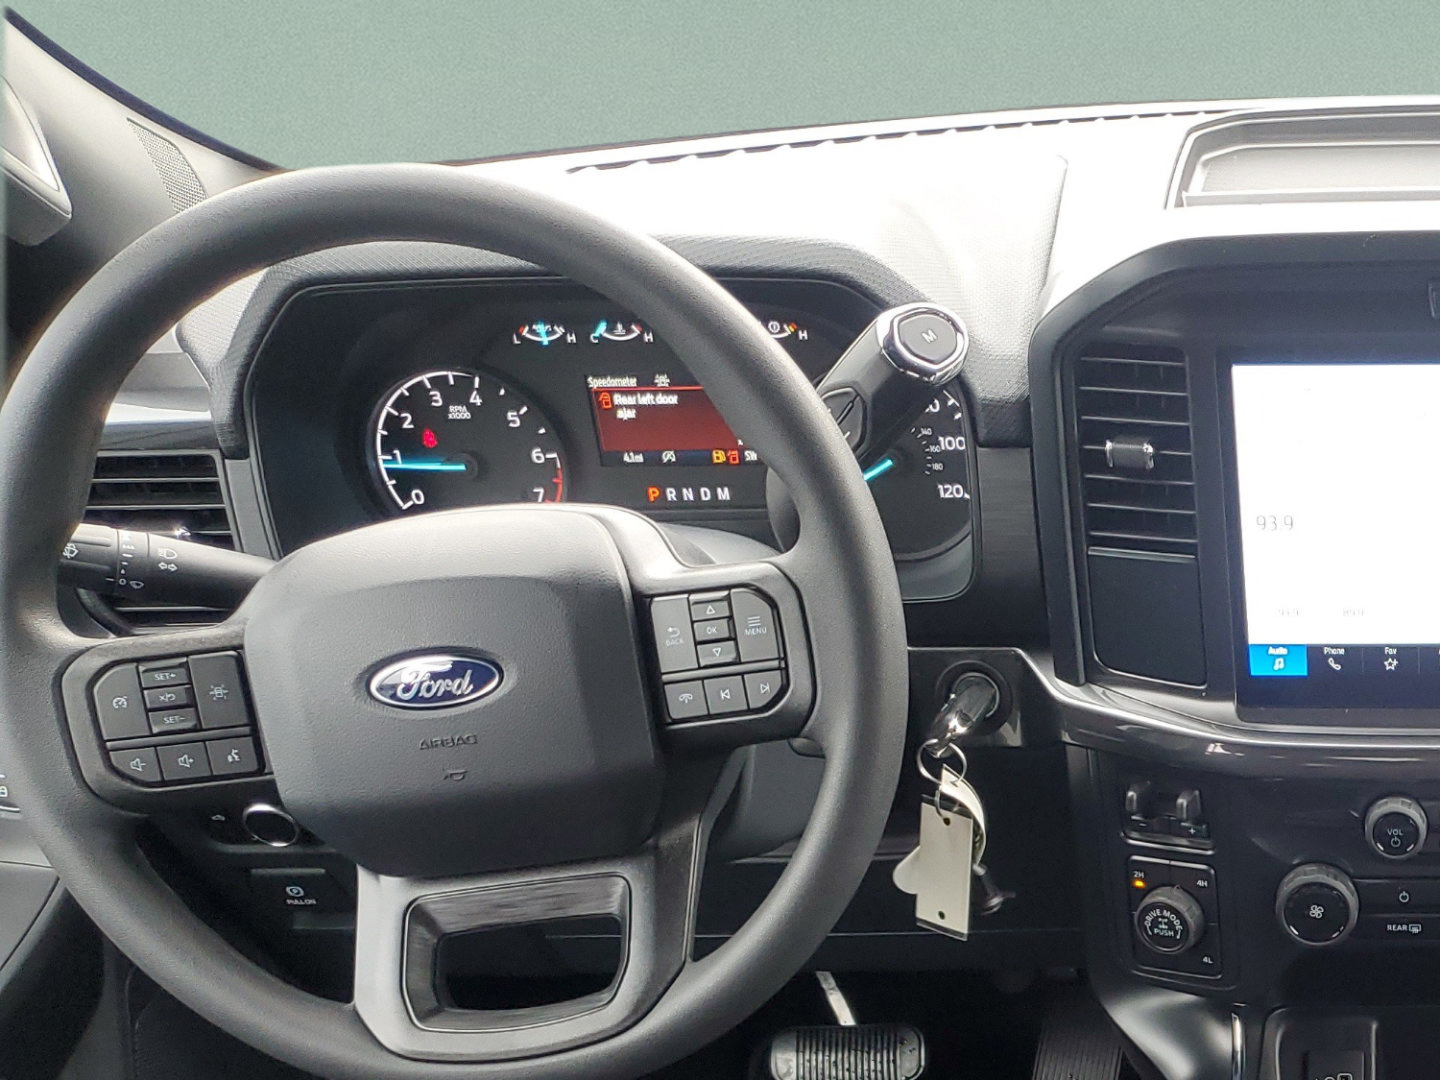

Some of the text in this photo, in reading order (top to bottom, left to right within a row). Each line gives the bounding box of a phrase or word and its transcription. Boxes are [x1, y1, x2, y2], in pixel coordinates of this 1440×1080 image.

[513, 334, 520, 344] L
[567, 334, 576, 343] H
[590, 334, 598, 343] C
[644, 333, 653, 342] H
[799, 330, 808, 340] H
[922, 330, 937, 343] M
[587, 376, 637, 388] Speedometer
[429, 391, 442, 406] 3
[470, 391, 482, 405] 4
[613, 392, 678, 404] Rear left door
[507, 412, 521, 427] 5
[617, 407, 636, 421] ajar
[401, 414, 414, 428] 2
[921, 428, 932, 436] 140
[938, 437, 965, 450] 100
[393, 450, 402, 464] 1
[531, 449, 545, 463] 6
[932, 463, 943, 471] 180
[412, 490, 424, 504] 0
[532, 488, 544, 502] 7
[647, 487, 730, 501] P R N D M
[938, 485, 964, 498] 120
[706, 626, 718, 635] OK
[745, 626, 767, 635] MENU
[665, 638, 684, 646] BACK
[1268, 647, 1288, 655] Audio
[1324, 647, 1344, 655] Phone
[1385, 647, 1397, 655] Fav
[419, 734, 478, 750] AIRBAG
[1144, 909, 1183, 931] DRIVE MODE
[1154, 928, 1174, 937] PUSH
[1203, 956, 1214, 964] 4L
